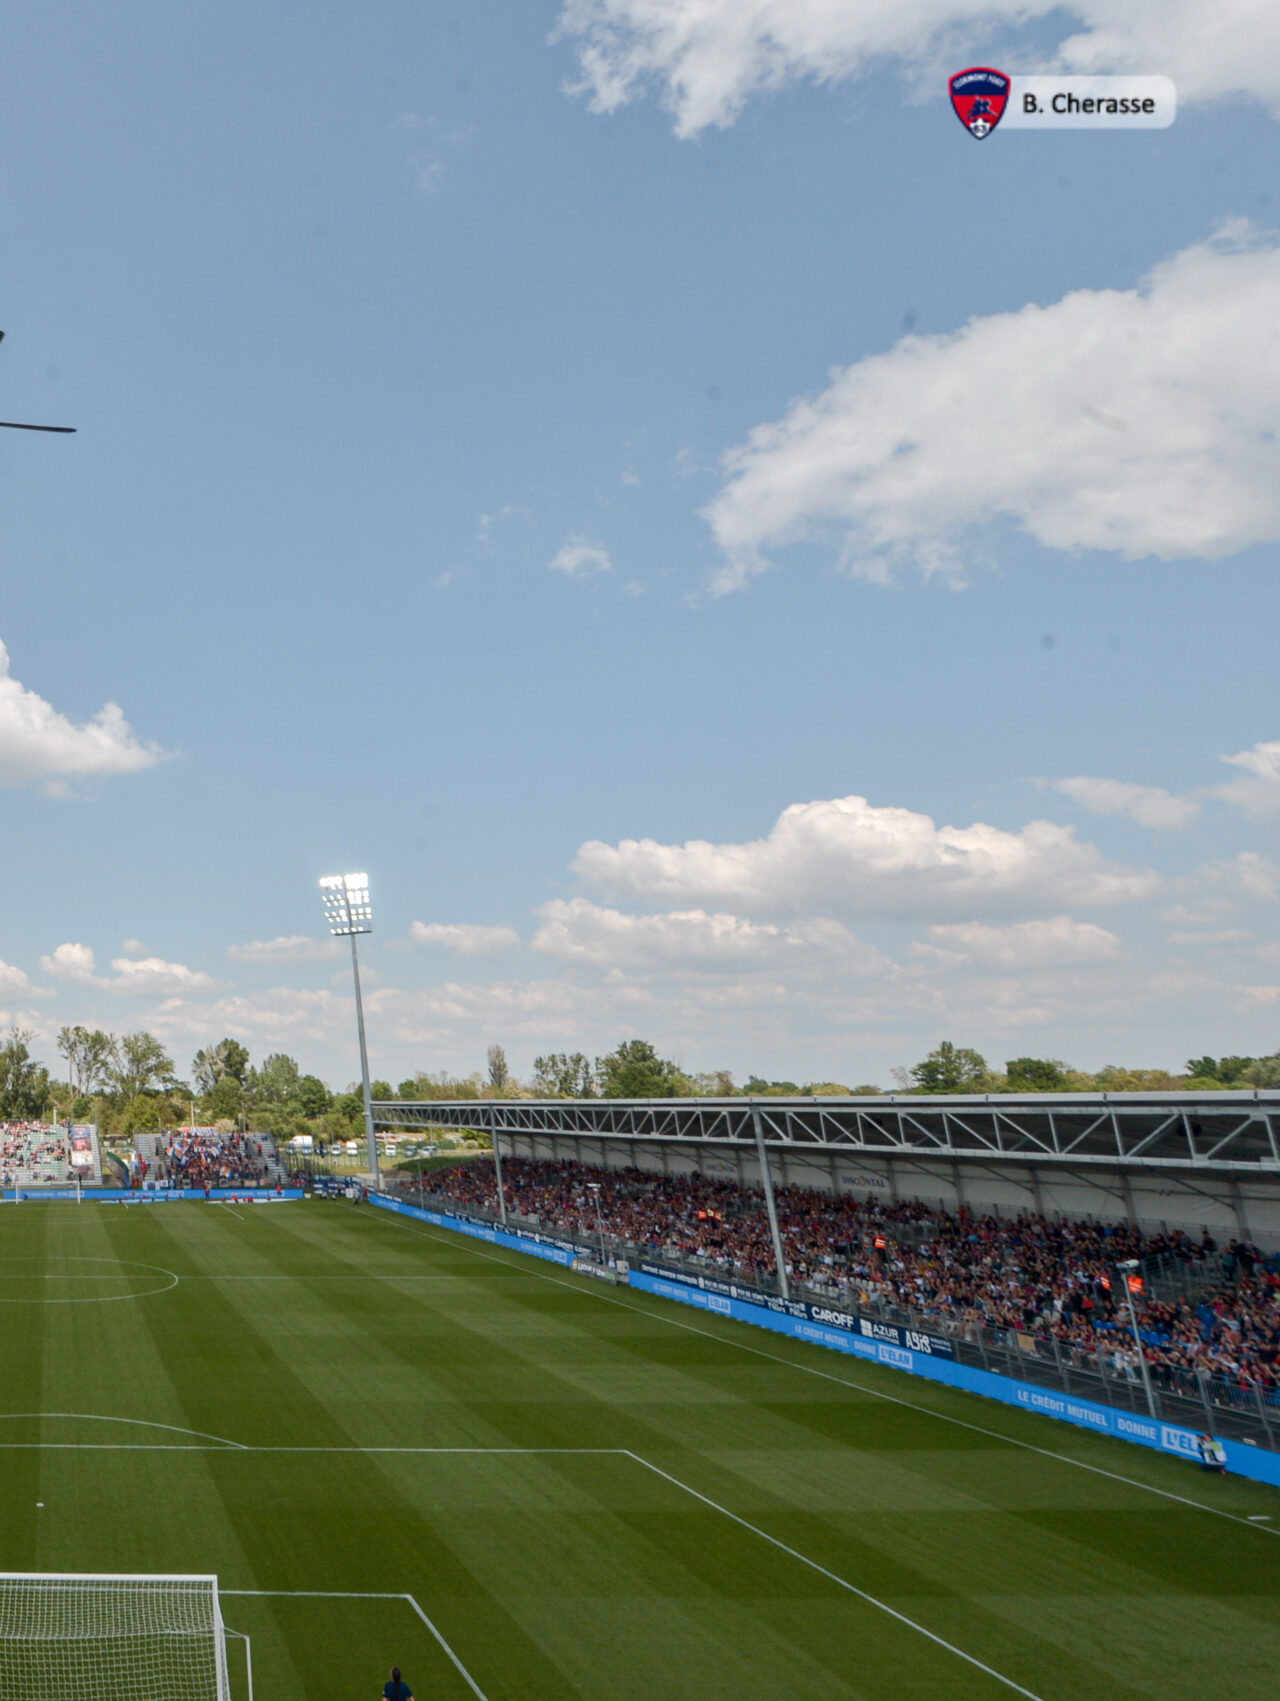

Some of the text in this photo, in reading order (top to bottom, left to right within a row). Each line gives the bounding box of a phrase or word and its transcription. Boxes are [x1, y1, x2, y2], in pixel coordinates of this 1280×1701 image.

[811, 1306, 854, 1328] CAROFF
[873, 1324, 900, 1339] AZUR
[1017, 1389, 1029, 1402] LE
[1031, 1394, 1065, 1413] CRÉDIT
[1067, 1405, 1109, 1427] MUTUEL
[1118, 1418, 1157, 1440] DONNE
